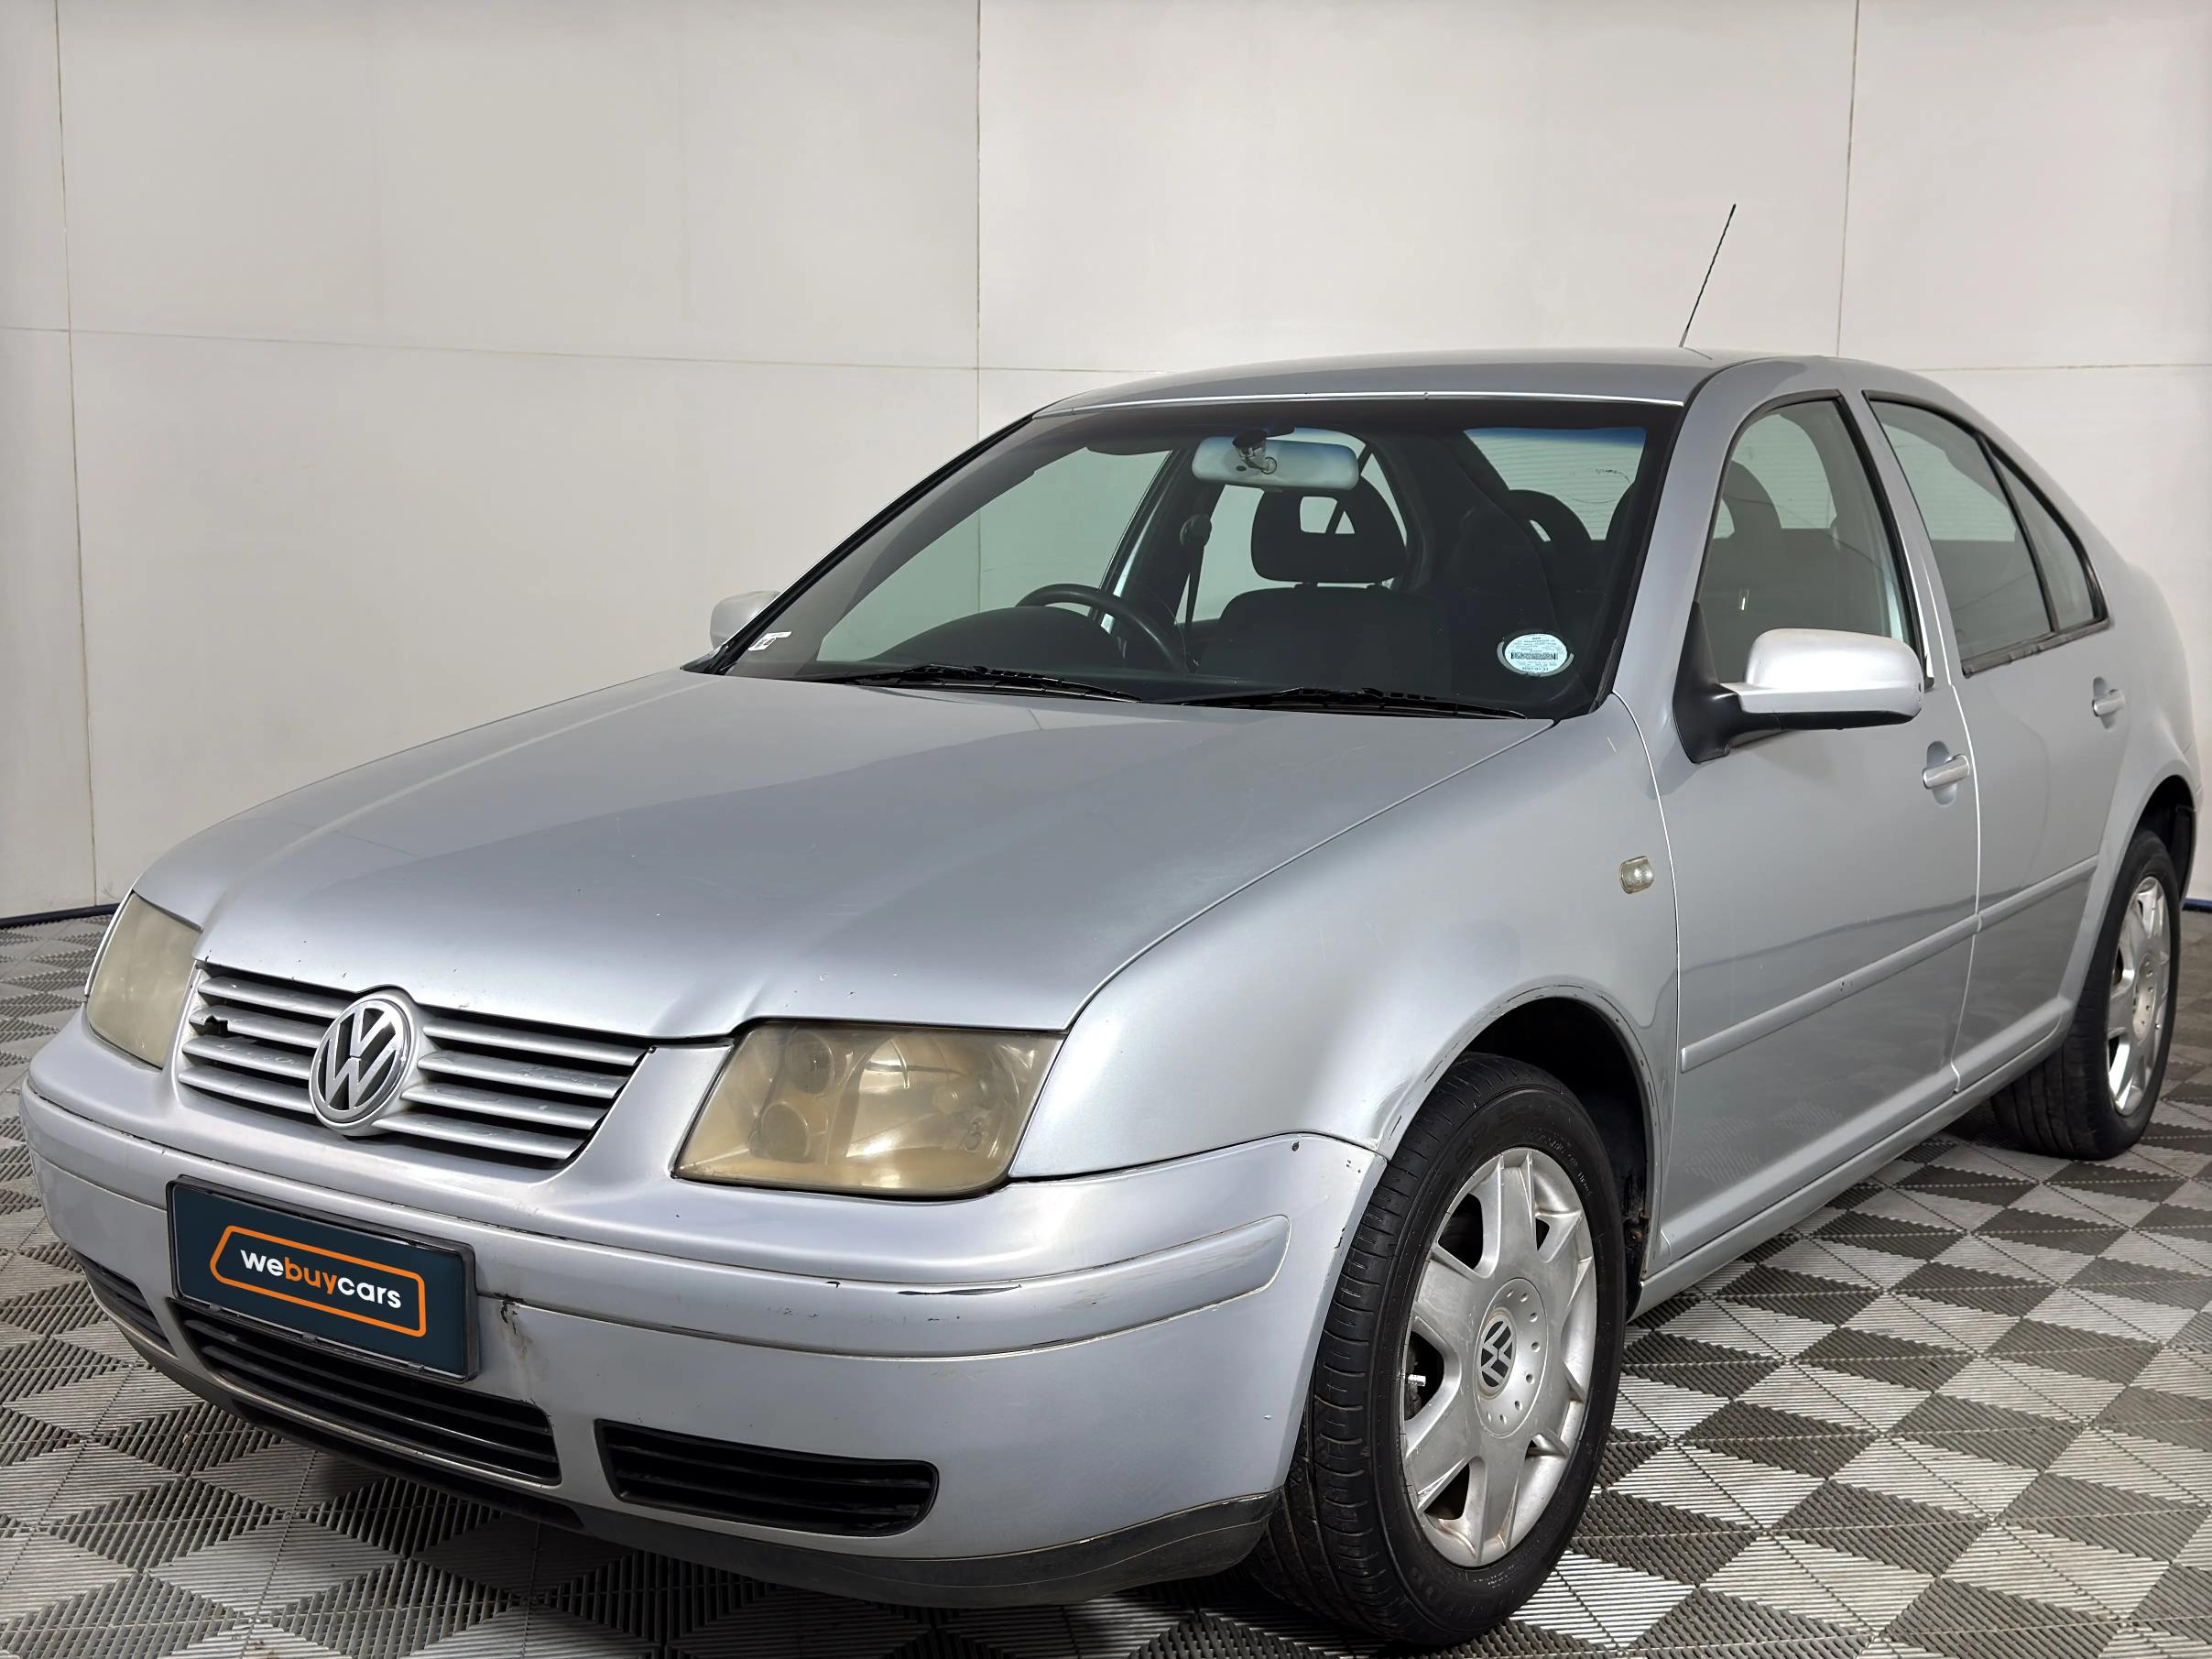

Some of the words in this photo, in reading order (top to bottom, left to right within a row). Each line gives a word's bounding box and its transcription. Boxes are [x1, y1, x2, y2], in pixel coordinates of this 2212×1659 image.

[316, 999, 406, 1115] VW
[240, 1249, 402, 1309] webuycars
[1478, 1317, 1514, 1391] VW
